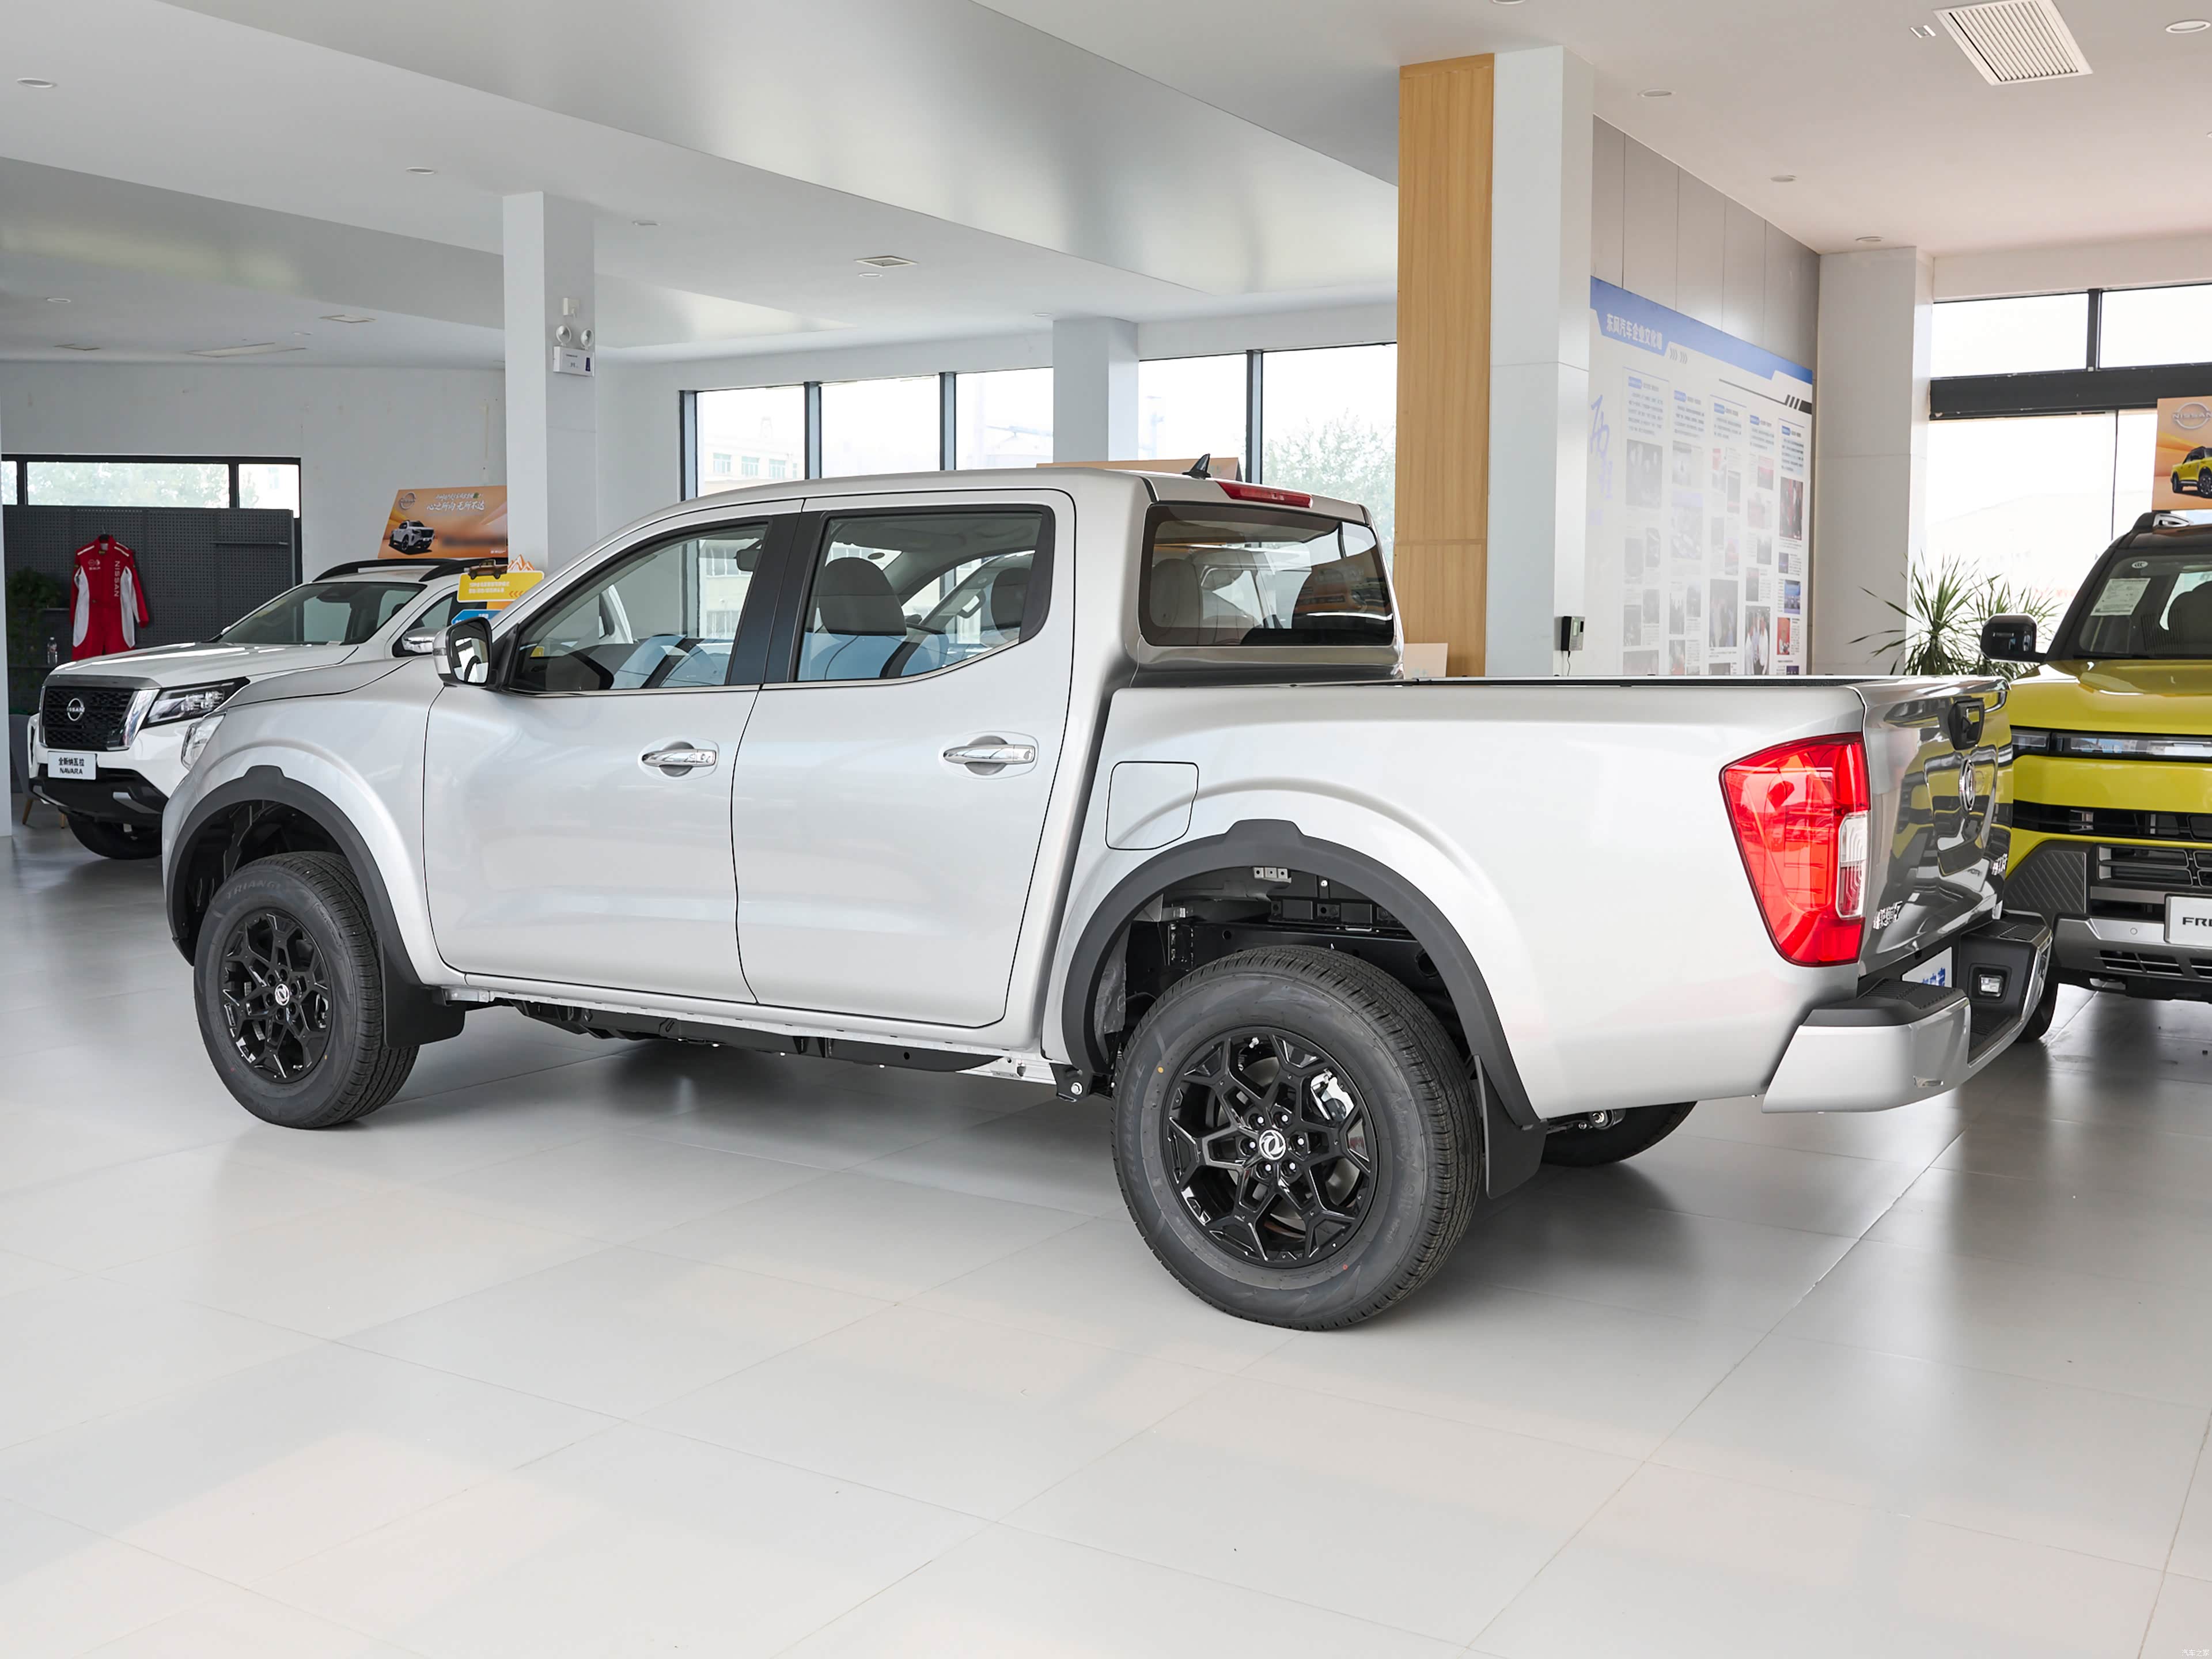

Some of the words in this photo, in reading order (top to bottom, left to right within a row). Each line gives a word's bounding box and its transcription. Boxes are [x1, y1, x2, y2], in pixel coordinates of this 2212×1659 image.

[58, 756, 85, 767] 全新纳瓦拉
[2182, 916, 2212, 927] FR
